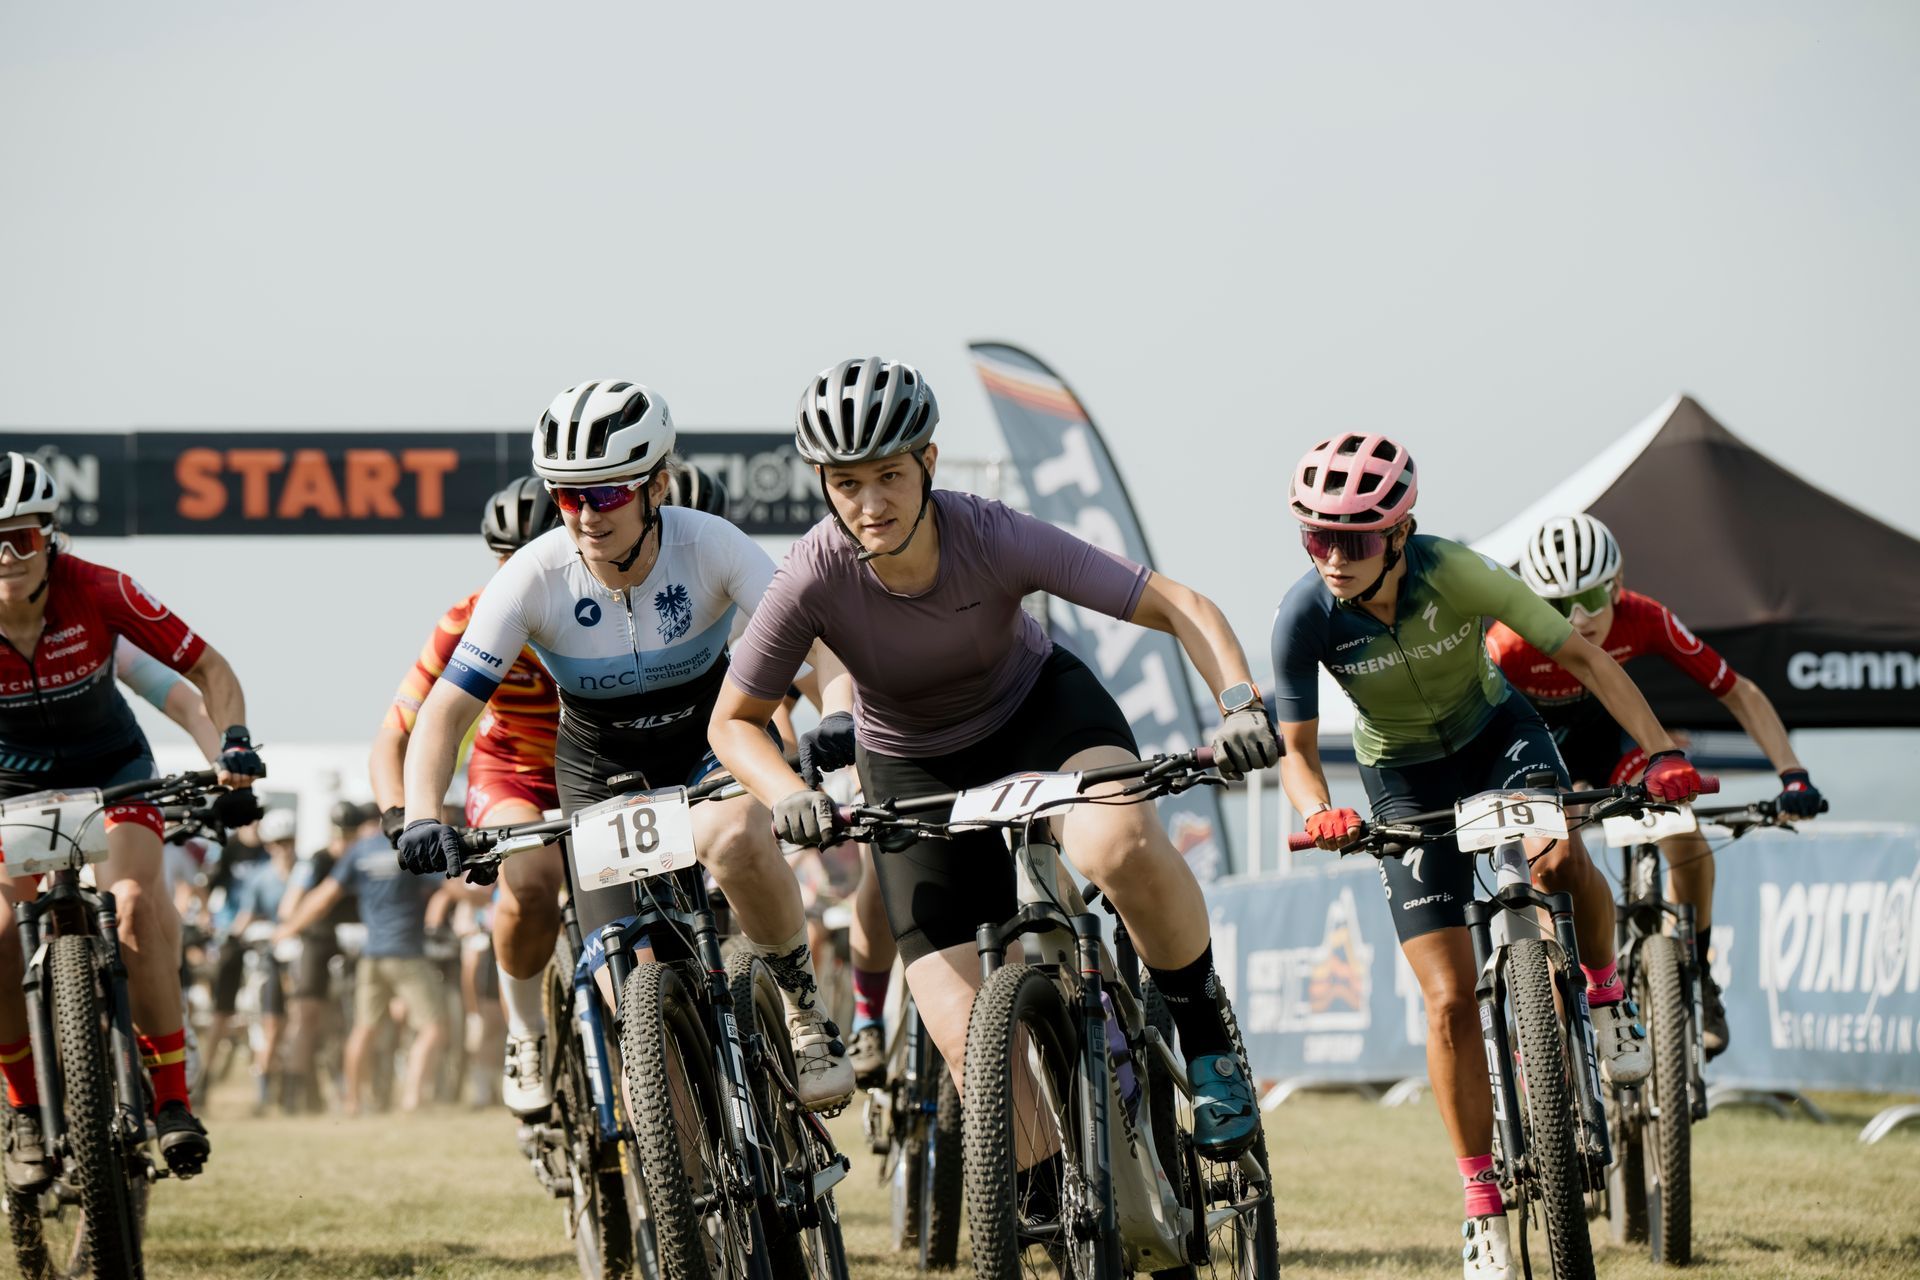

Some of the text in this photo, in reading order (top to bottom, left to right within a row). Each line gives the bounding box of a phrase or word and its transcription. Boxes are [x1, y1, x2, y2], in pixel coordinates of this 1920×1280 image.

[176, 447, 459, 520] START
[1331, 622, 1472, 675] GREENLINEVELO
[1335, 636, 1368, 651] CRAFT
[645, 647, 709, 673] northampton
[646, 667, 691, 681] cycling
[693, 653, 712, 670] club
[1787, 651, 1920, 690] cann
[579, 671, 636, 690] ncc
[1502, 763, 1539, 789] CRAFT
[990, 779, 1045, 812] 77
[41, 807, 61, 852] 7
[1488, 801, 1535, 828] 19
[607, 807, 660, 859] 18
[1403, 893, 1442, 910] CRAFT
[1776, 1011, 1920, 1054] ENGINEERIN
